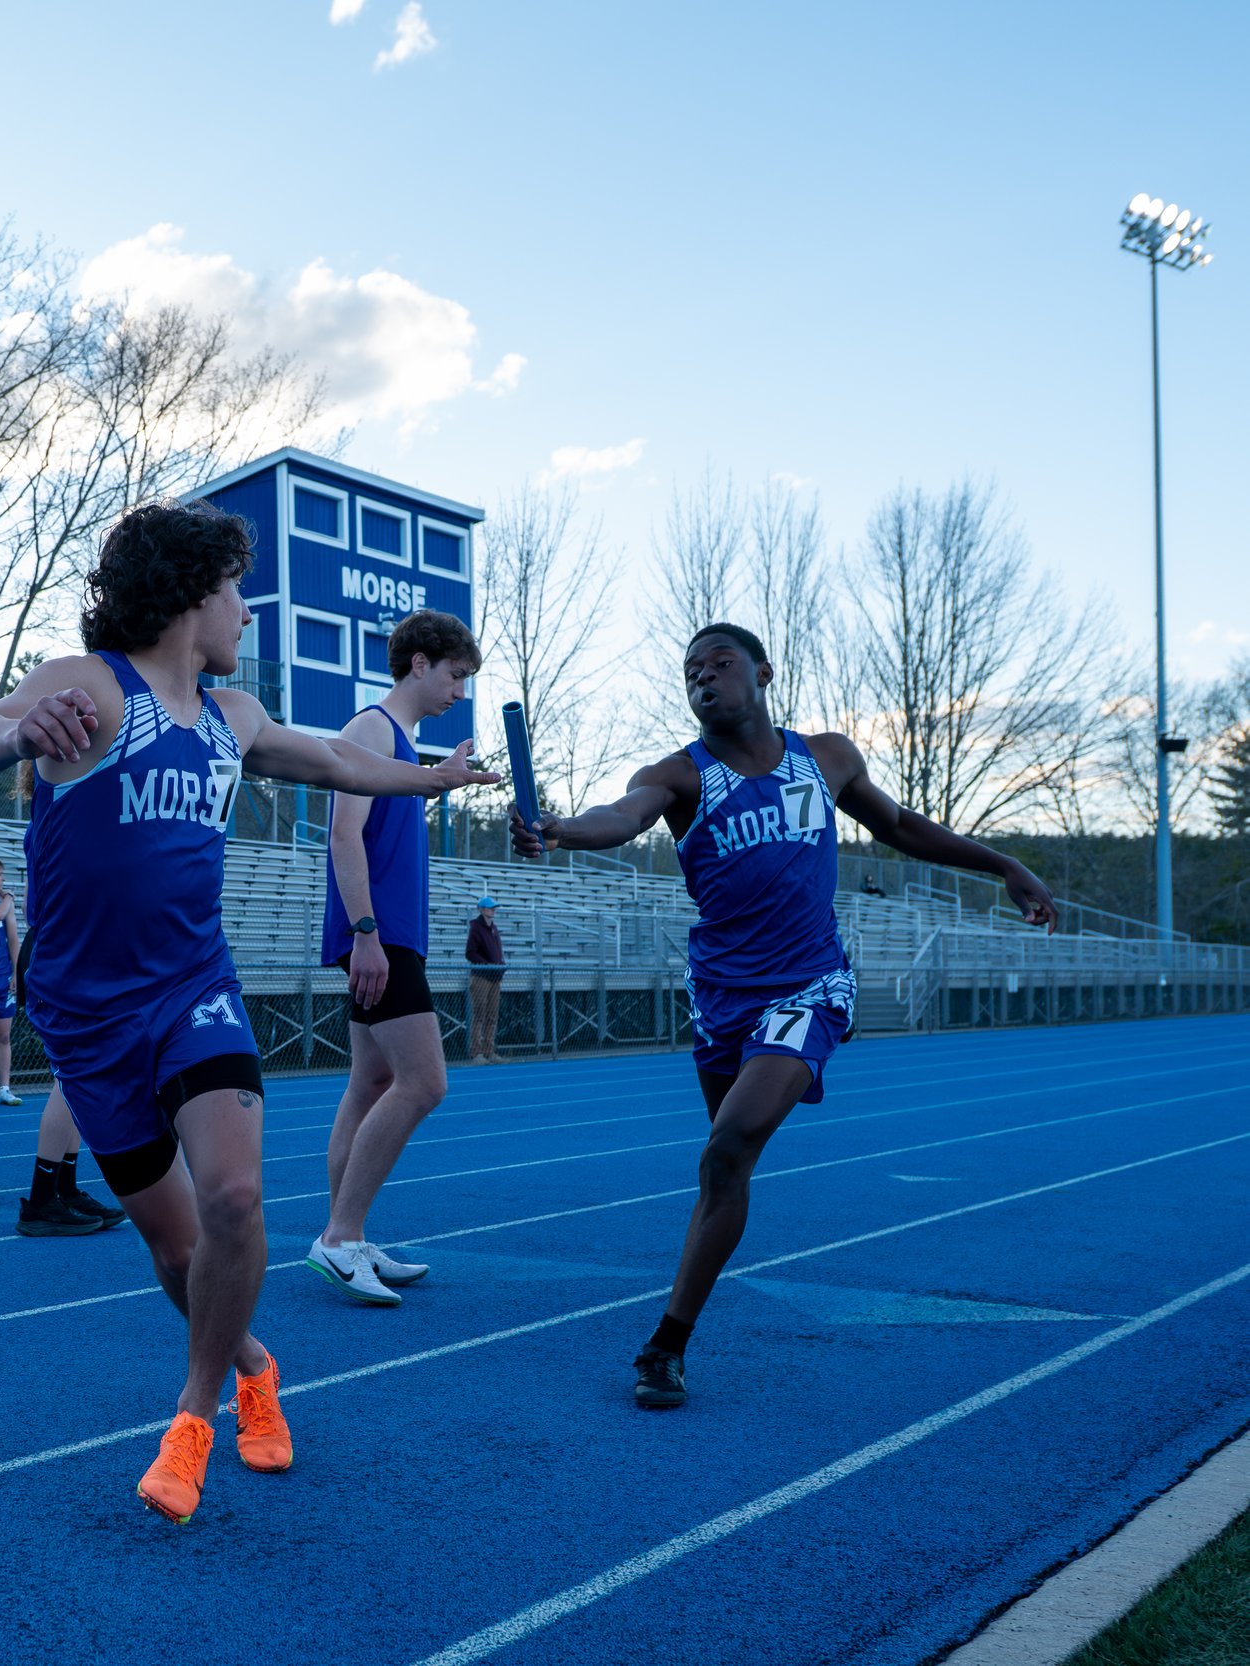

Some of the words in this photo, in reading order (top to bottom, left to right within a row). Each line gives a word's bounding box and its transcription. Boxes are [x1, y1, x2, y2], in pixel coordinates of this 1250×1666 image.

[341, 566, 426, 612] MORSE
[119, 768, 227, 834] MORS
[214, 765, 239, 823] 7
[785, 783, 814, 829] 7
[191, 992, 243, 1029] M
[773, 1010, 806, 1042] 7
